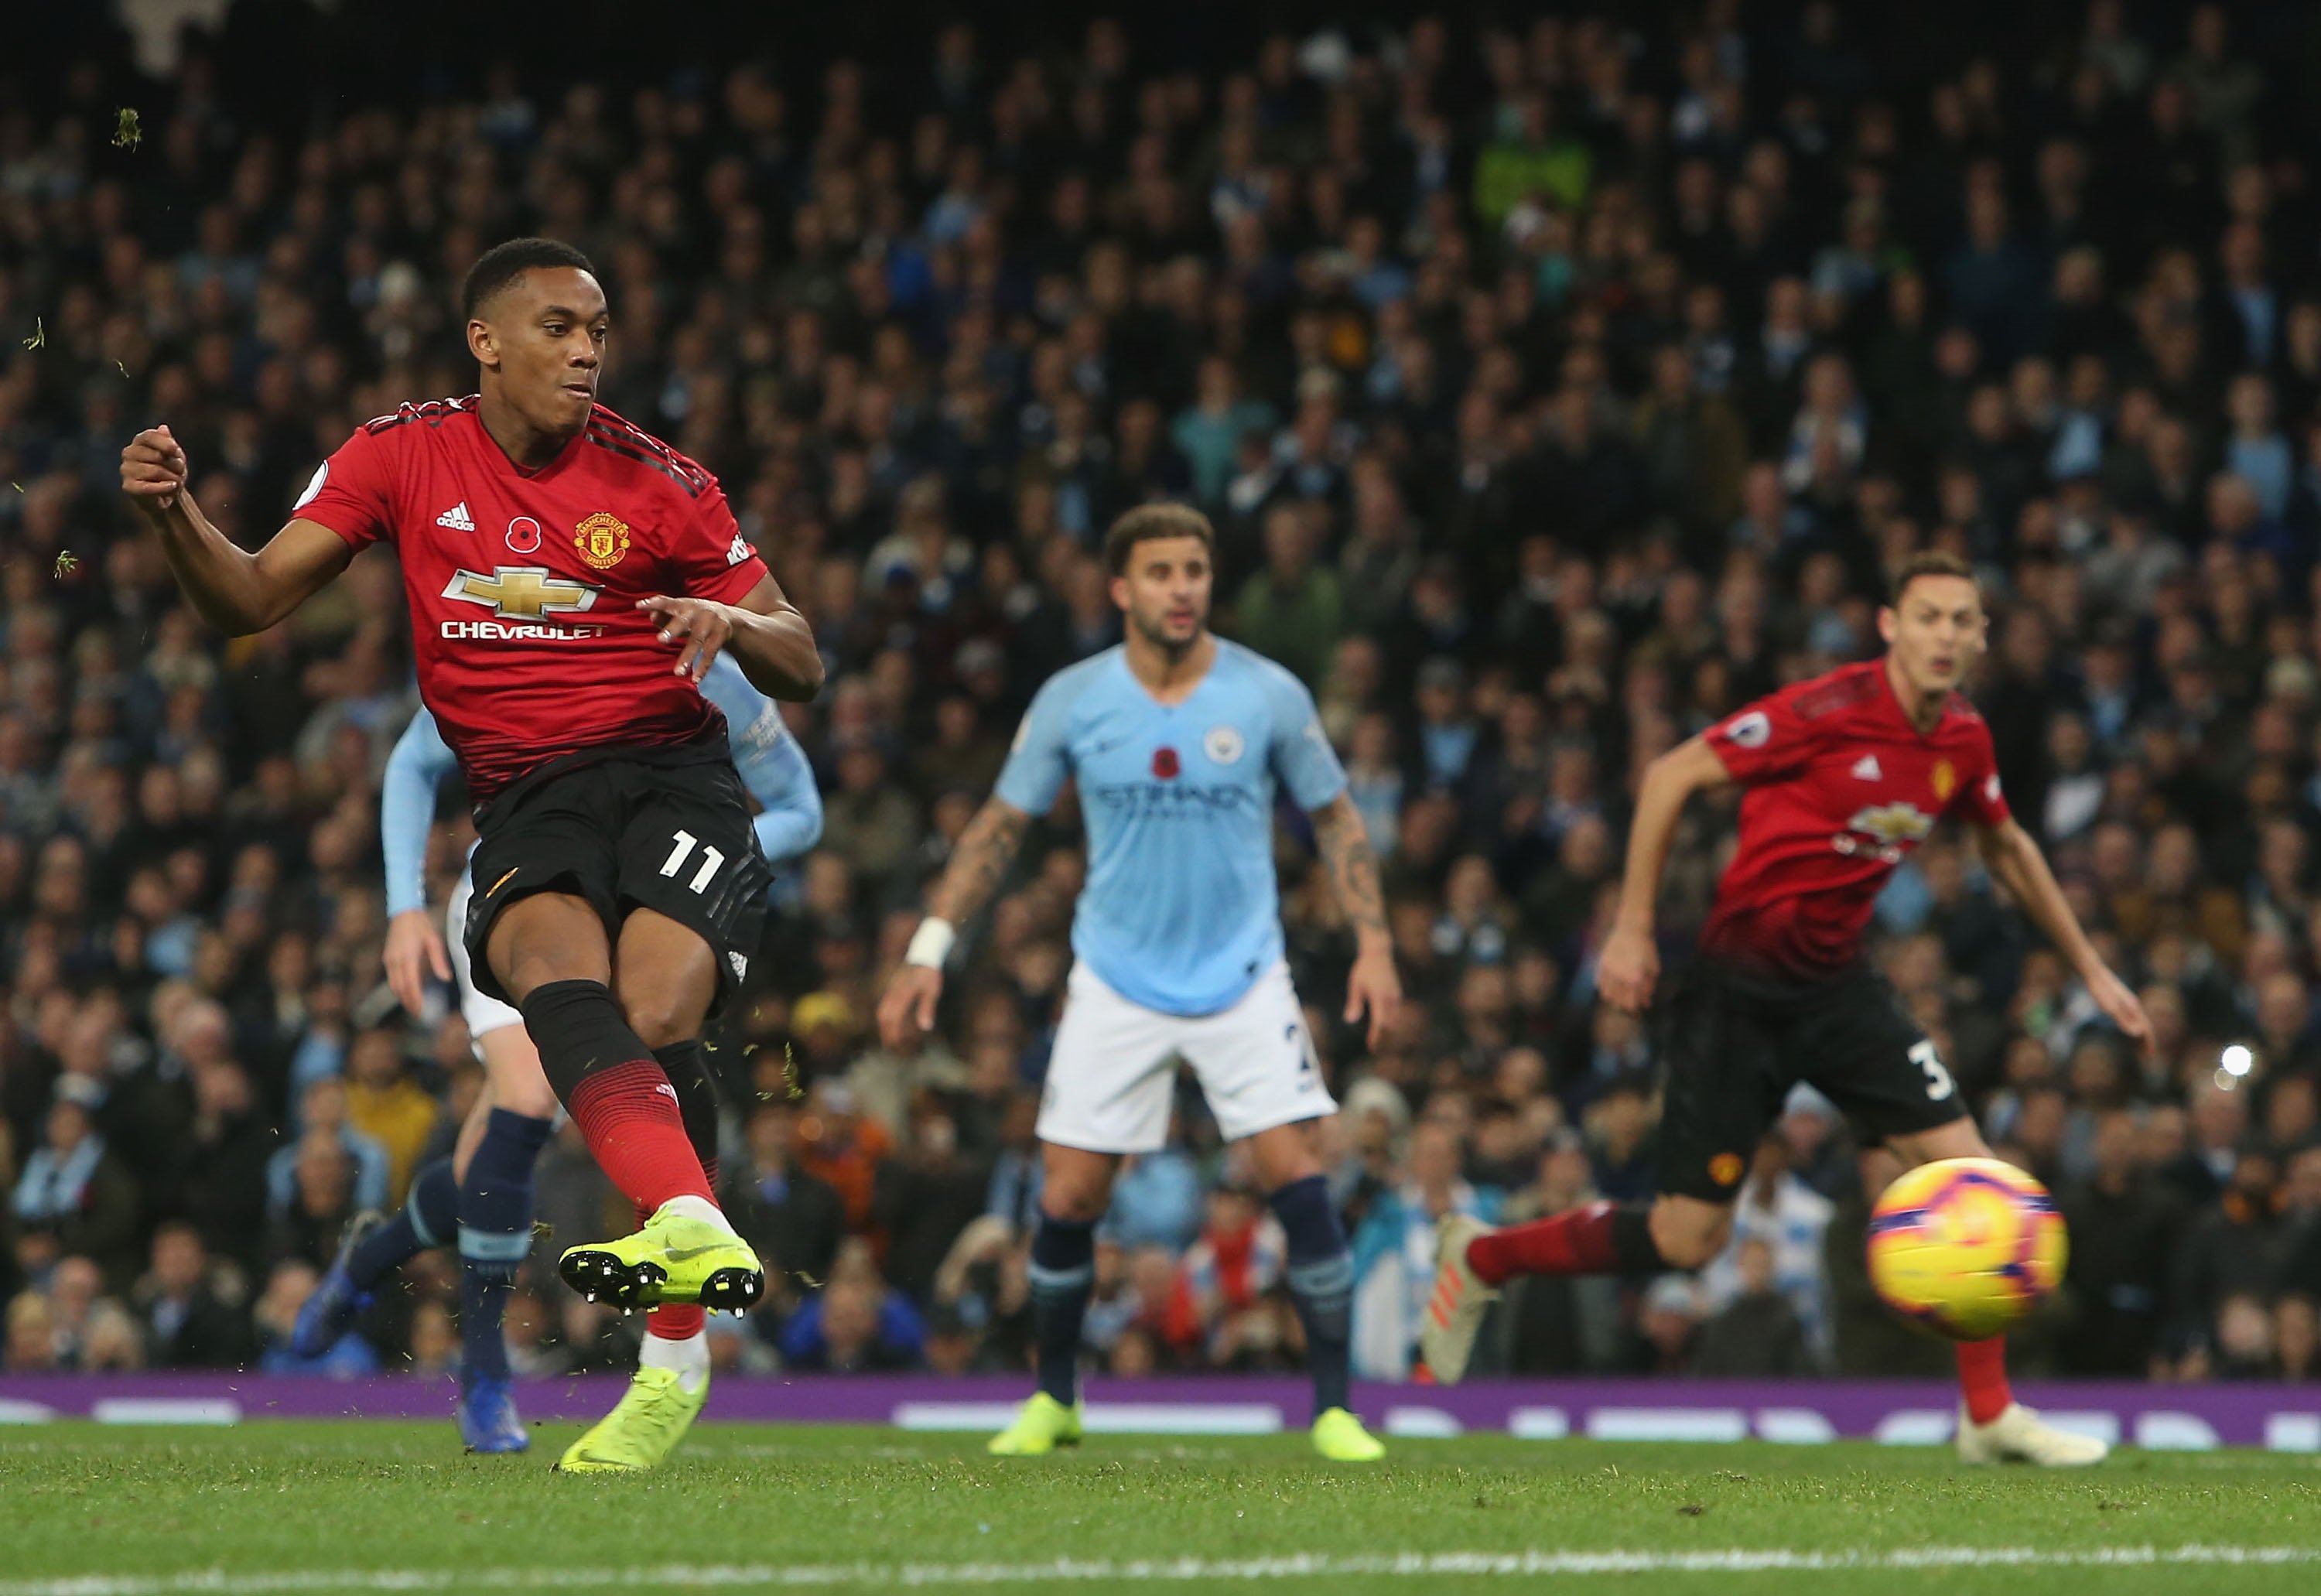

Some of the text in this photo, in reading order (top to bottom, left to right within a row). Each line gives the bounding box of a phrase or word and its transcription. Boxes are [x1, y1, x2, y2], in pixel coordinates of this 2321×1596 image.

[436, 516, 476, 532] adidas
[579, 516, 625, 535] MANCHESTER
[586, 555, 618, 565] UNITED
[441, 621, 608, 641] CHEVROLET
[659, 829, 726, 895] 11
